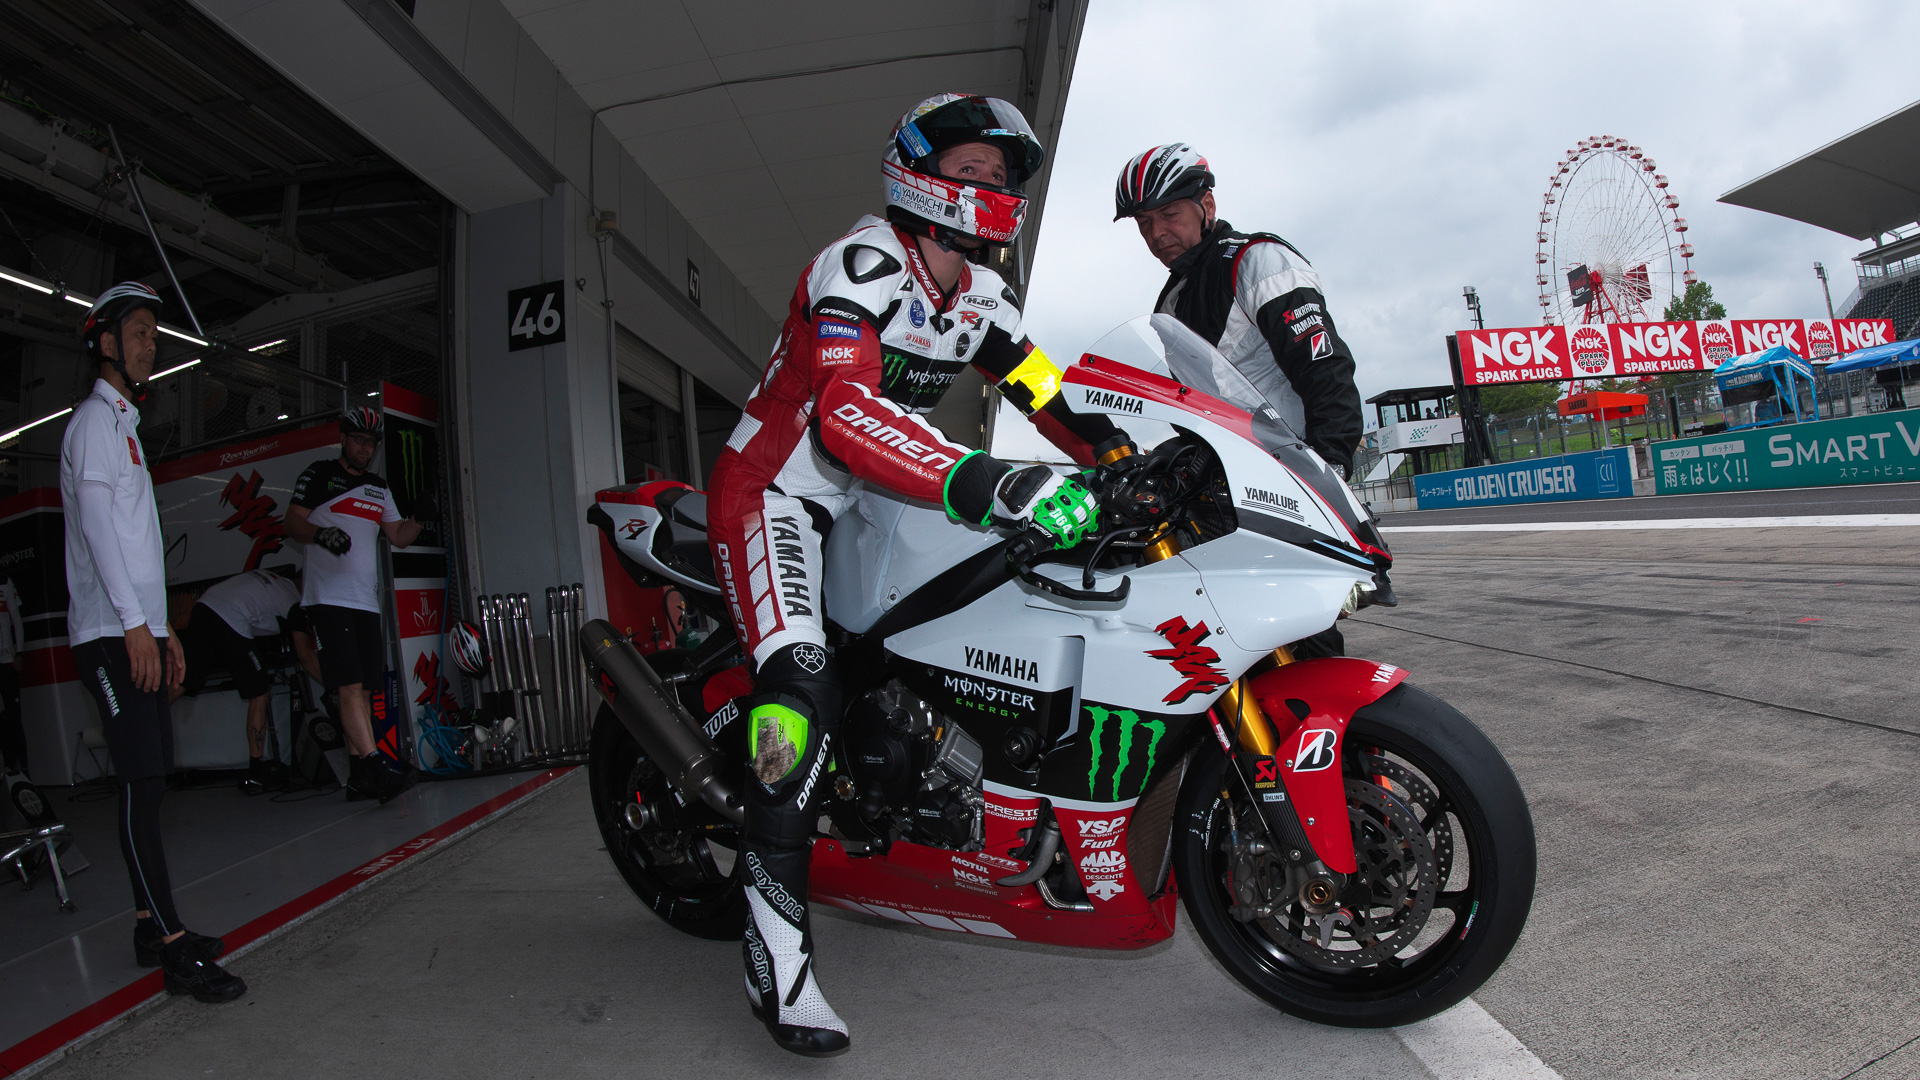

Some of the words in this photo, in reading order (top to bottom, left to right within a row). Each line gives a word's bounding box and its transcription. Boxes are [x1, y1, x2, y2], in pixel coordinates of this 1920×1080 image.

[901, 197, 941, 219] ELECTRONICS
[902, 187, 944, 211] YAMAICHI
[689, 268, 699, 300] 47
[967, 297, 995, 307] HJC
[511, 292, 561, 339] 46
[819, 307, 859, 320] DAMEN
[828, 325, 858, 336] YAMAHA
[1705, 333, 1728, 344] NGK
[1740, 321, 1801, 354] NGK
[1810, 330, 1831, 340] NGK
[1839, 321, 1887, 350] NGK
[1471, 328, 1560, 368] NGK
[1575, 338, 1603, 350] NGK
[1619, 323, 1692, 359] NGK
[1708, 346, 1729, 354] SPARK
[822, 347, 855, 361] NGK
[1579, 352, 1604, 360] SPARK
[1580, 359, 1606, 368] PLUGS
[1475, 370, 1520, 384] SPARK
[1521, 366, 1562, 380] PLUGS
[1624, 362, 1660, 373] SPARK
[1661, 359, 1695, 371] PLUGS
[906, 369, 957, 385] MONSTE
[1085, 389, 1143, 415] YAMAHA
[833, 403, 956, 470] DAMEN
[1669, 449, 1691, 458] カンタン
[1711, 443, 1734, 453] バッチリ
[1768, 432, 1891, 468] SMART
[219, 451, 243, 466] Revs
[881, 451, 941, 482] ANNIVERSARY
[1454, 473, 1507, 501] GOLDEN
[1508, 465, 1577, 498] CRUISER
[1245, 487, 1300, 513] YAMALUBE
[618, 518, 650, 540] R1
[770, 515, 813, 618] YAMAHA
[964, 646, 1039, 683] YAMAHA
[100, 675, 120, 718] YAMAHA
[944, 675, 1036, 711] MONSTER
[373, 689, 386, 720] TOP
[956, 697, 1019, 718] ENERGY
[991, 811, 1038, 821] CORPORATION
[1077, 816, 1126, 834] YSP
[1080, 834, 1120, 849] Fun!
[951, 855, 989, 874] MOTUL
[1080, 863, 1127, 873] TOOLS
[953, 867, 992, 887] NGK
[1085, 872, 1124, 880] DESCENTE
[745, 852, 805, 922] daytona
[922, 906, 991, 920] ANNIVERSARY
